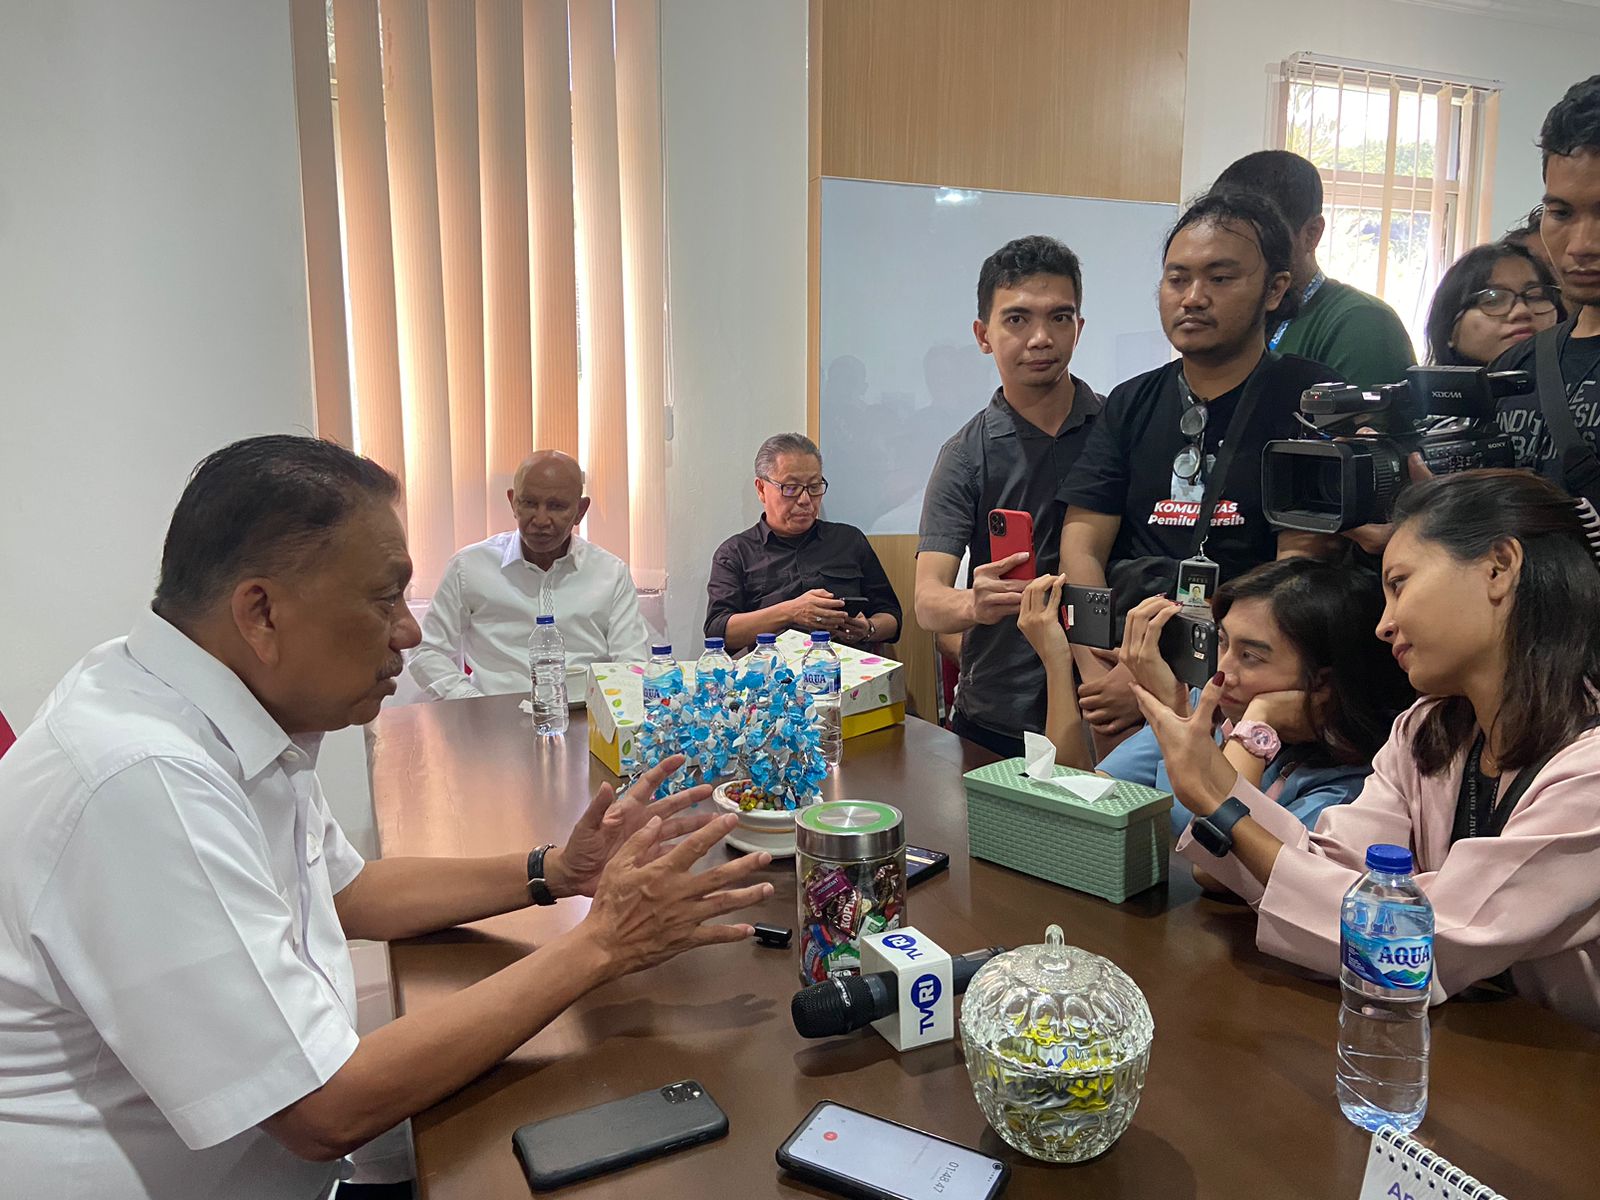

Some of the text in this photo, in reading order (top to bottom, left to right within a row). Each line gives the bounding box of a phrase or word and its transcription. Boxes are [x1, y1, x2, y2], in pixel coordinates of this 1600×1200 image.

[1431, 390, 1462, 399] XDCAM
[1487, 441, 1506, 449] SONY
[1147, 514, 1245, 527] Pemilu ersih
[804, 673, 826, 685] AQUA
[885, 935, 923, 960] TVRI
[1378, 945, 1430, 969] AQUA
[916, 977, 937, 1035] TVRI
